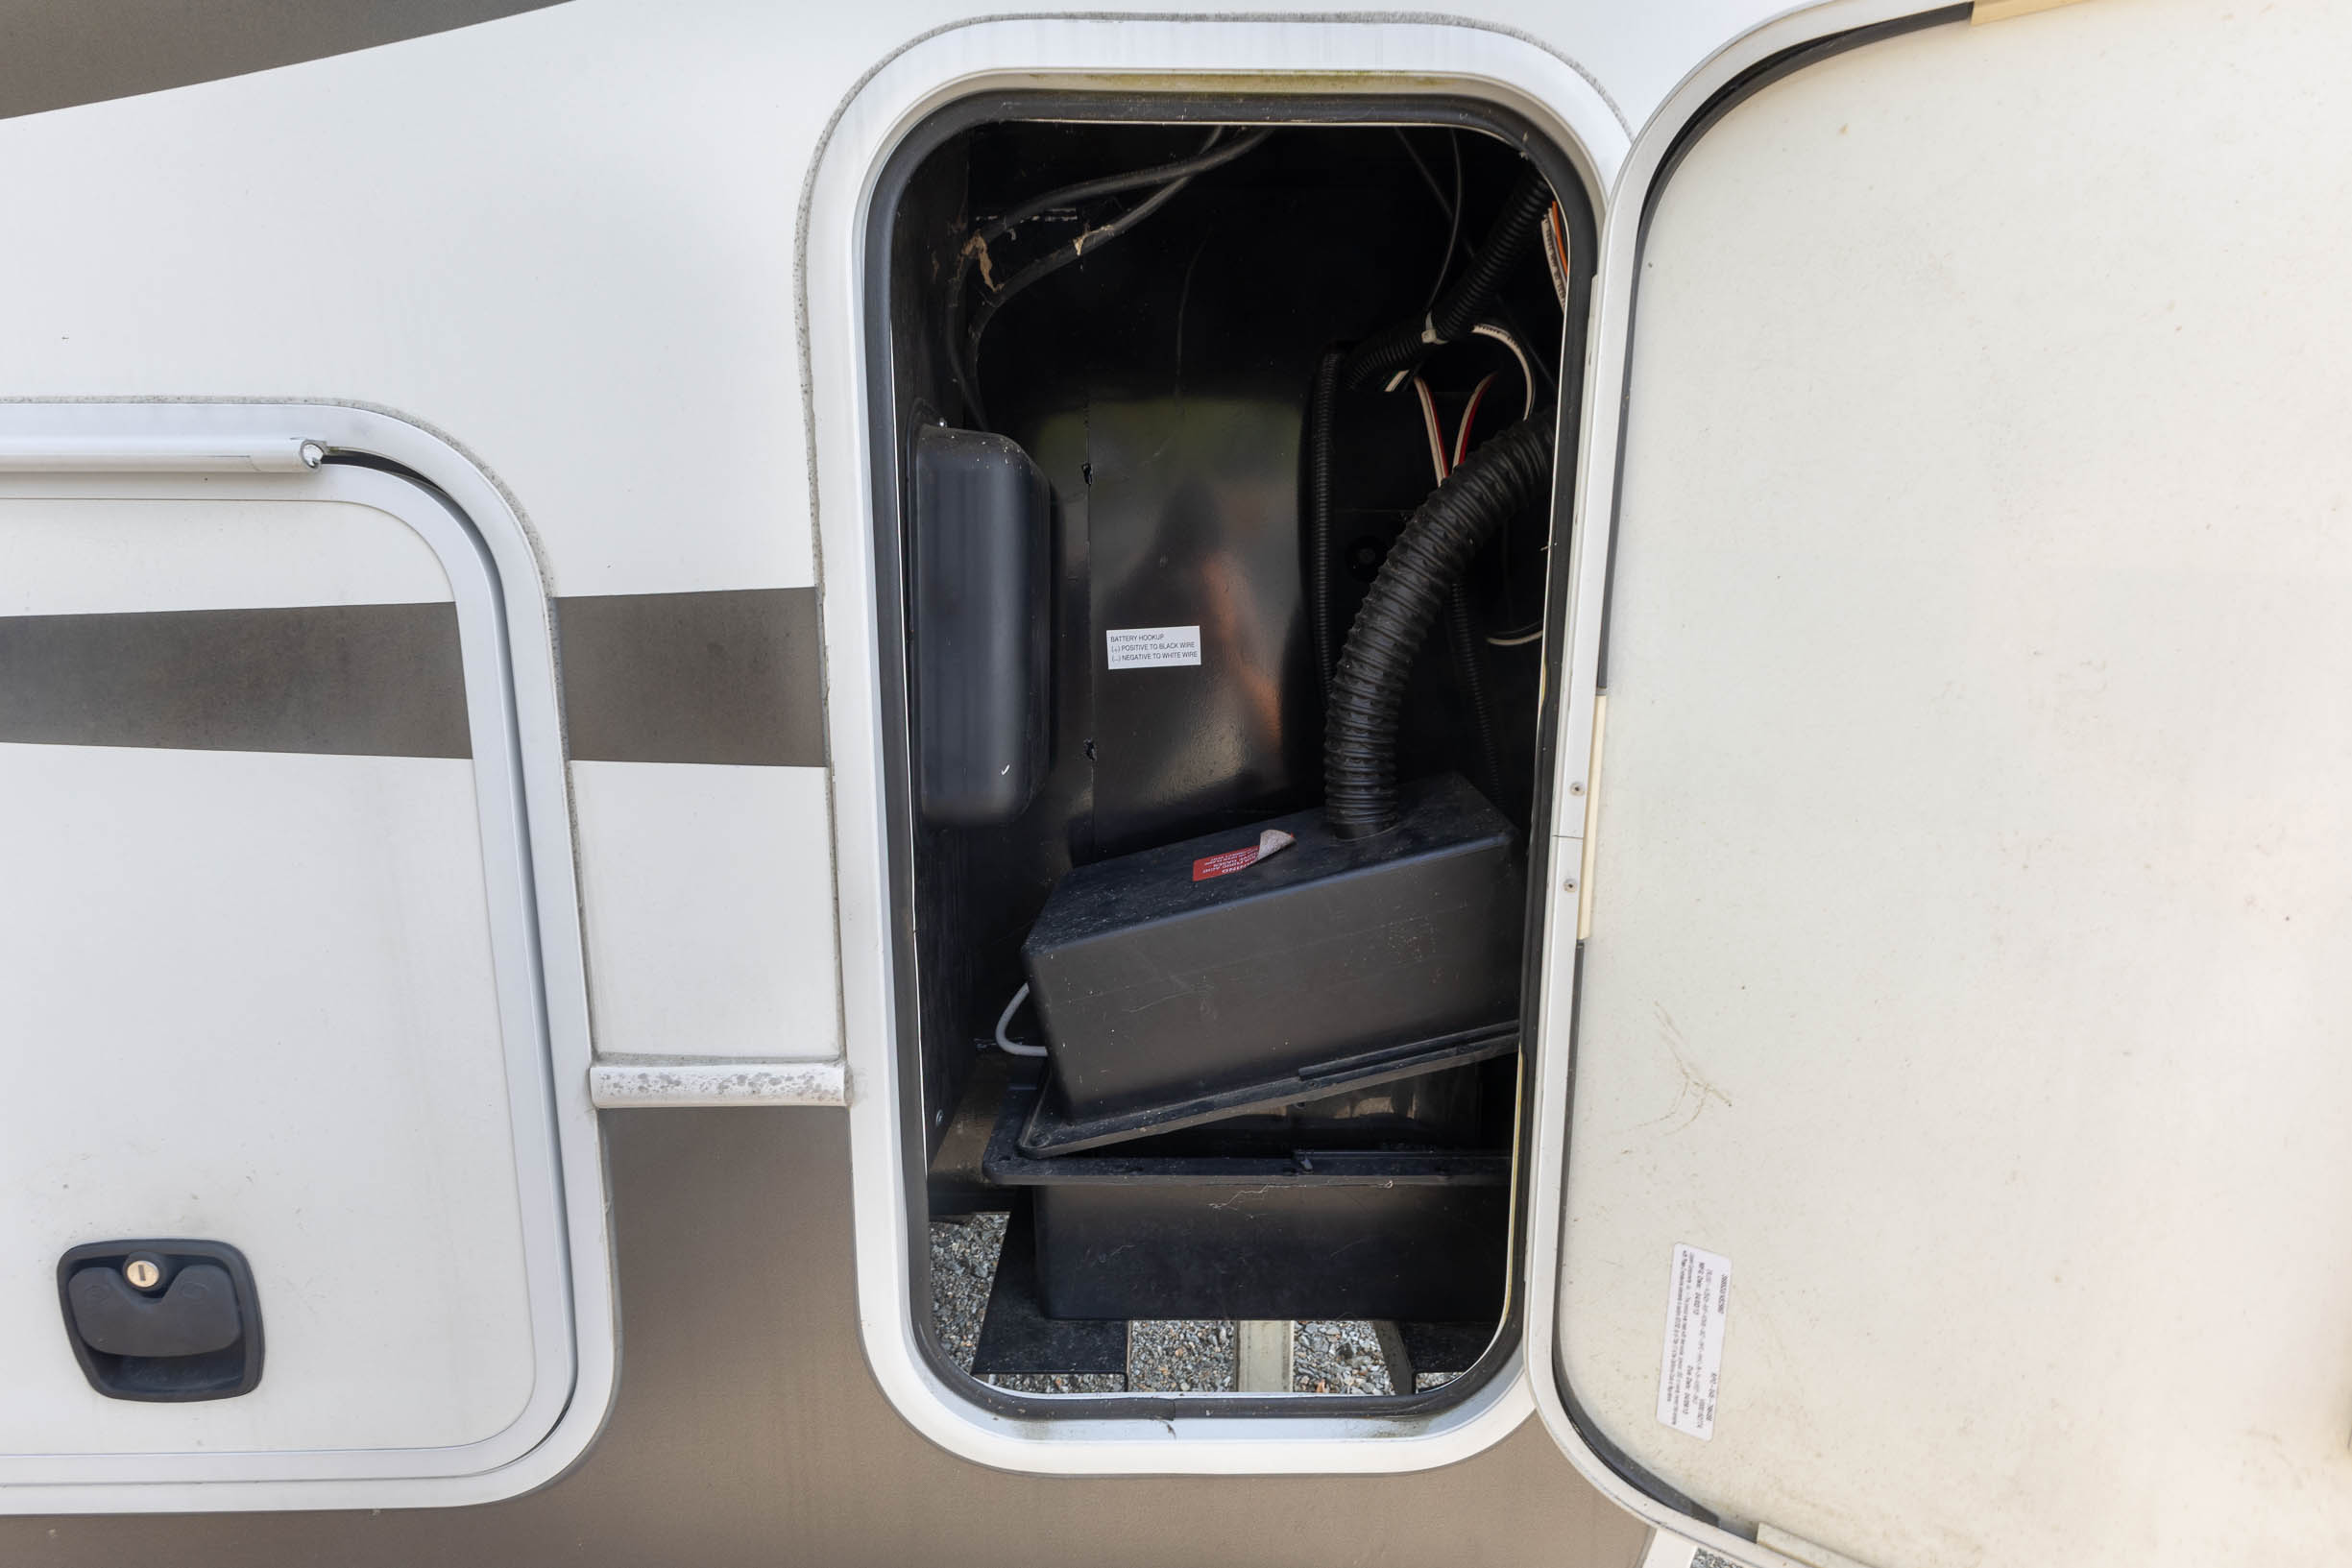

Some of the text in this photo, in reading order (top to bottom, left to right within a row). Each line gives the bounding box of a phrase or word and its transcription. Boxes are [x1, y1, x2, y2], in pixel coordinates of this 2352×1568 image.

[1110, 635, 1138, 643] BATTERY
[1122, 643, 1149, 652] POSITIVE
[1122, 653, 1152, 662] NEGATIVE
[1182, 650, 1199, 659] WIRE
